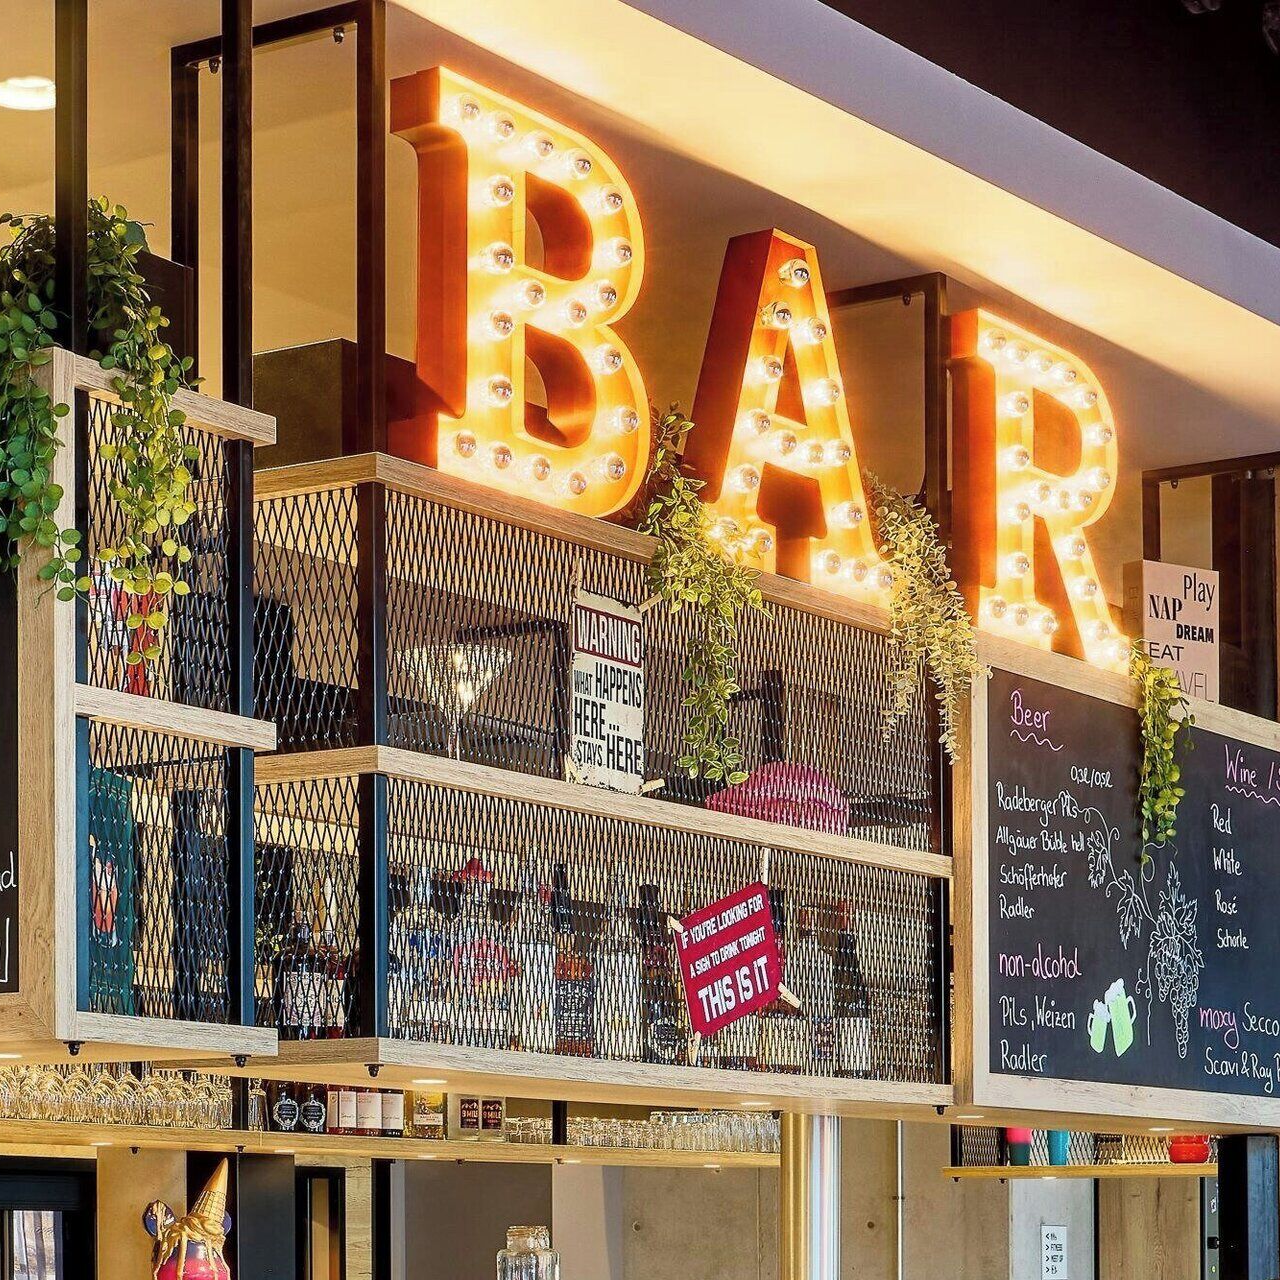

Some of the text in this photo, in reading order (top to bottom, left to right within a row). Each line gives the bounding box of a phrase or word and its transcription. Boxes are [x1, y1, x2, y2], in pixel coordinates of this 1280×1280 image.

[390, 65, 1130, 675] BAR
[1149, 594, 1182, 621] NAP
[1184, 572, 1216, 611] Play
[576, 608, 641, 665] WARNING
[1150, 642, 1184, 661] EAT
[1176, 624, 1214, 643] DREAM
[574, 662, 642, 707] WHAT HAPPENS
[1010, 690, 1050, 732] Beer
[577, 736, 642, 775] STAYS HERE
[1225, 745, 1258, 788] Wine
[996, 781, 1058, 827] Radeberger
[1211, 803, 1232, 835] Red
[1213, 849, 1243, 878] White
[680, 894, 764, 949] IF YOU'RE LOOKING FOR
[999, 893, 1035, 919] Radler
[1215, 889, 1238, 916] Rosé
[695, 956, 711, 975] SIGN
[711, 950, 720, 966] TO
[720, 940, 739, 962] DRINK
[739, 926, 766, 956] TONIGHT
[1000, 943, 1082, 979] non-alcohol
[698, 955, 769, 1023] THIS IS IT
[1200, 1001, 1280, 1049] moxy Secco
[1000, 1039, 1047, 1072] Radler
